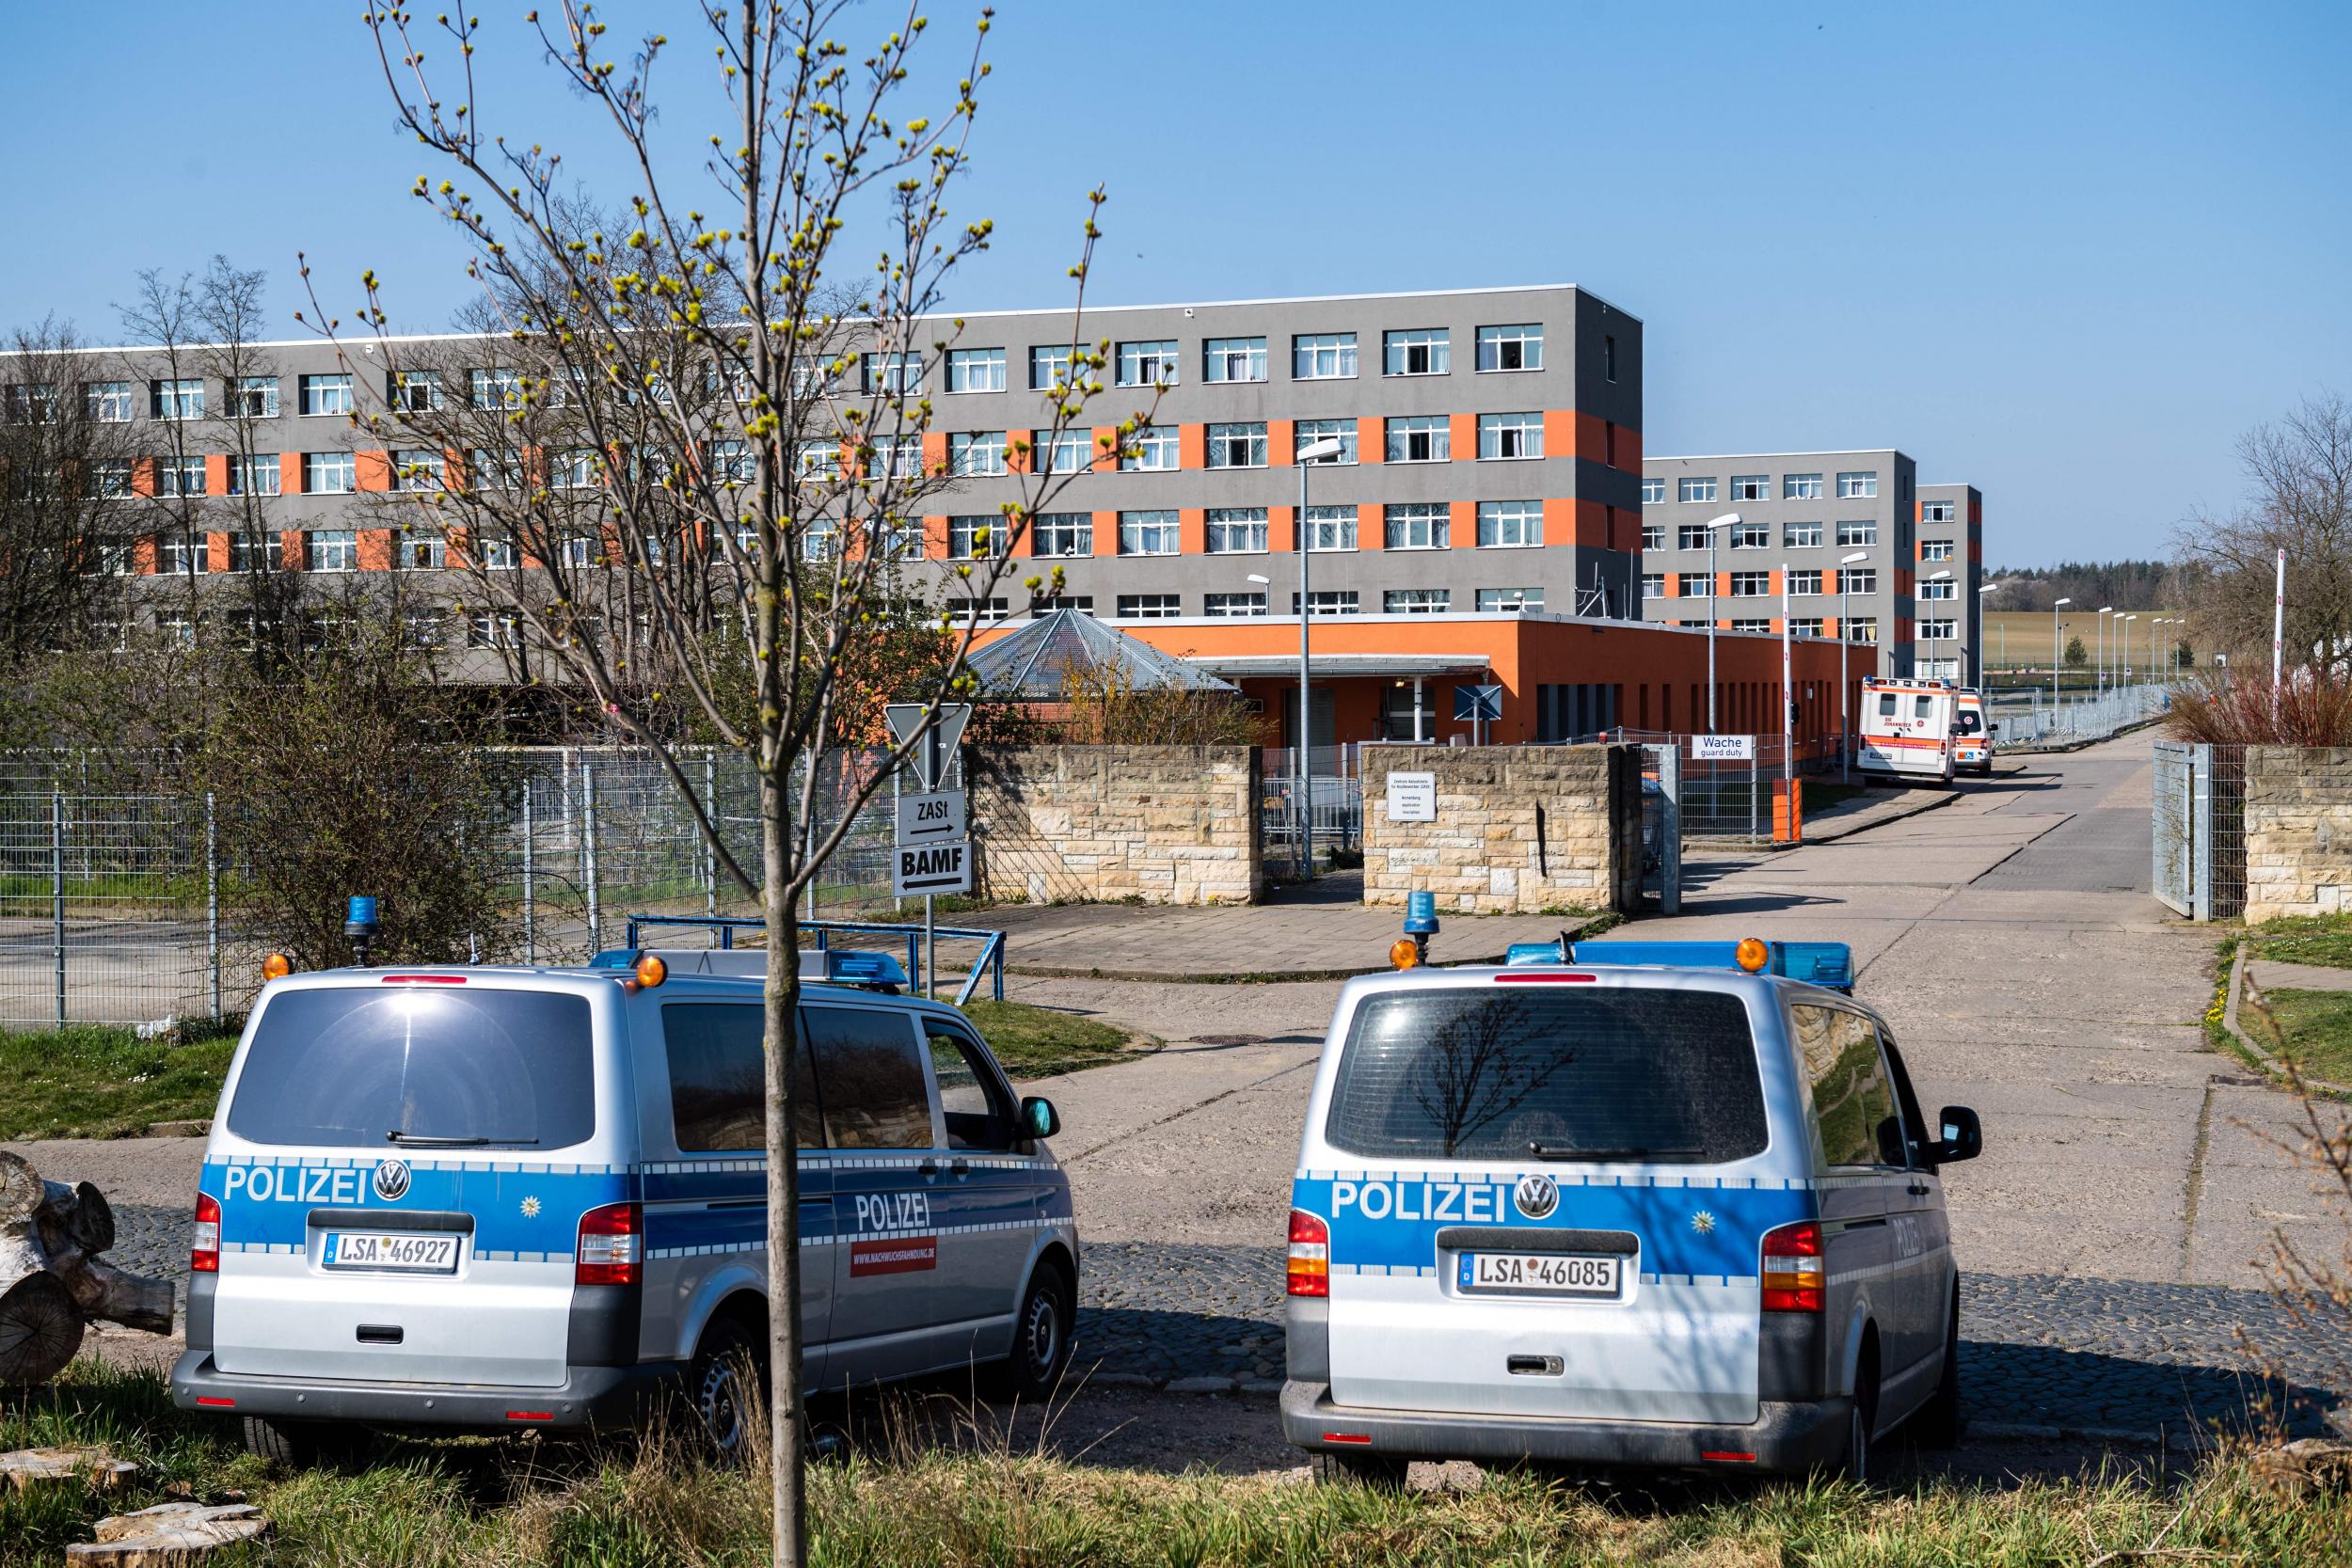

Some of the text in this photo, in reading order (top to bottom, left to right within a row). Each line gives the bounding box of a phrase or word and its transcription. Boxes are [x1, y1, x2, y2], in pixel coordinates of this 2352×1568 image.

[1701, 749, 1742, 757] guard duty
[1703, 737, 1741, 747] Wache
[917, 800, 948, 821] ZASt
[901, 847, 962, 877] BAMF
[224, 1166, 365, 1204] POLIZEI
[855, 1193, 930, 1231] POLIZEI
[1331, 1181, 1505, 1223] POLIZEI
[340, 1237, 376, 1261] LSA
[389, 1240, 451, 1263] 46927
[853, 1248, 935, 1265] WWW.NACHWUCHSFAHNDUNG.DE
[1480, 1258, 1523, 1283] LSA
[1539, 1259, 1611, 1287] 46085
